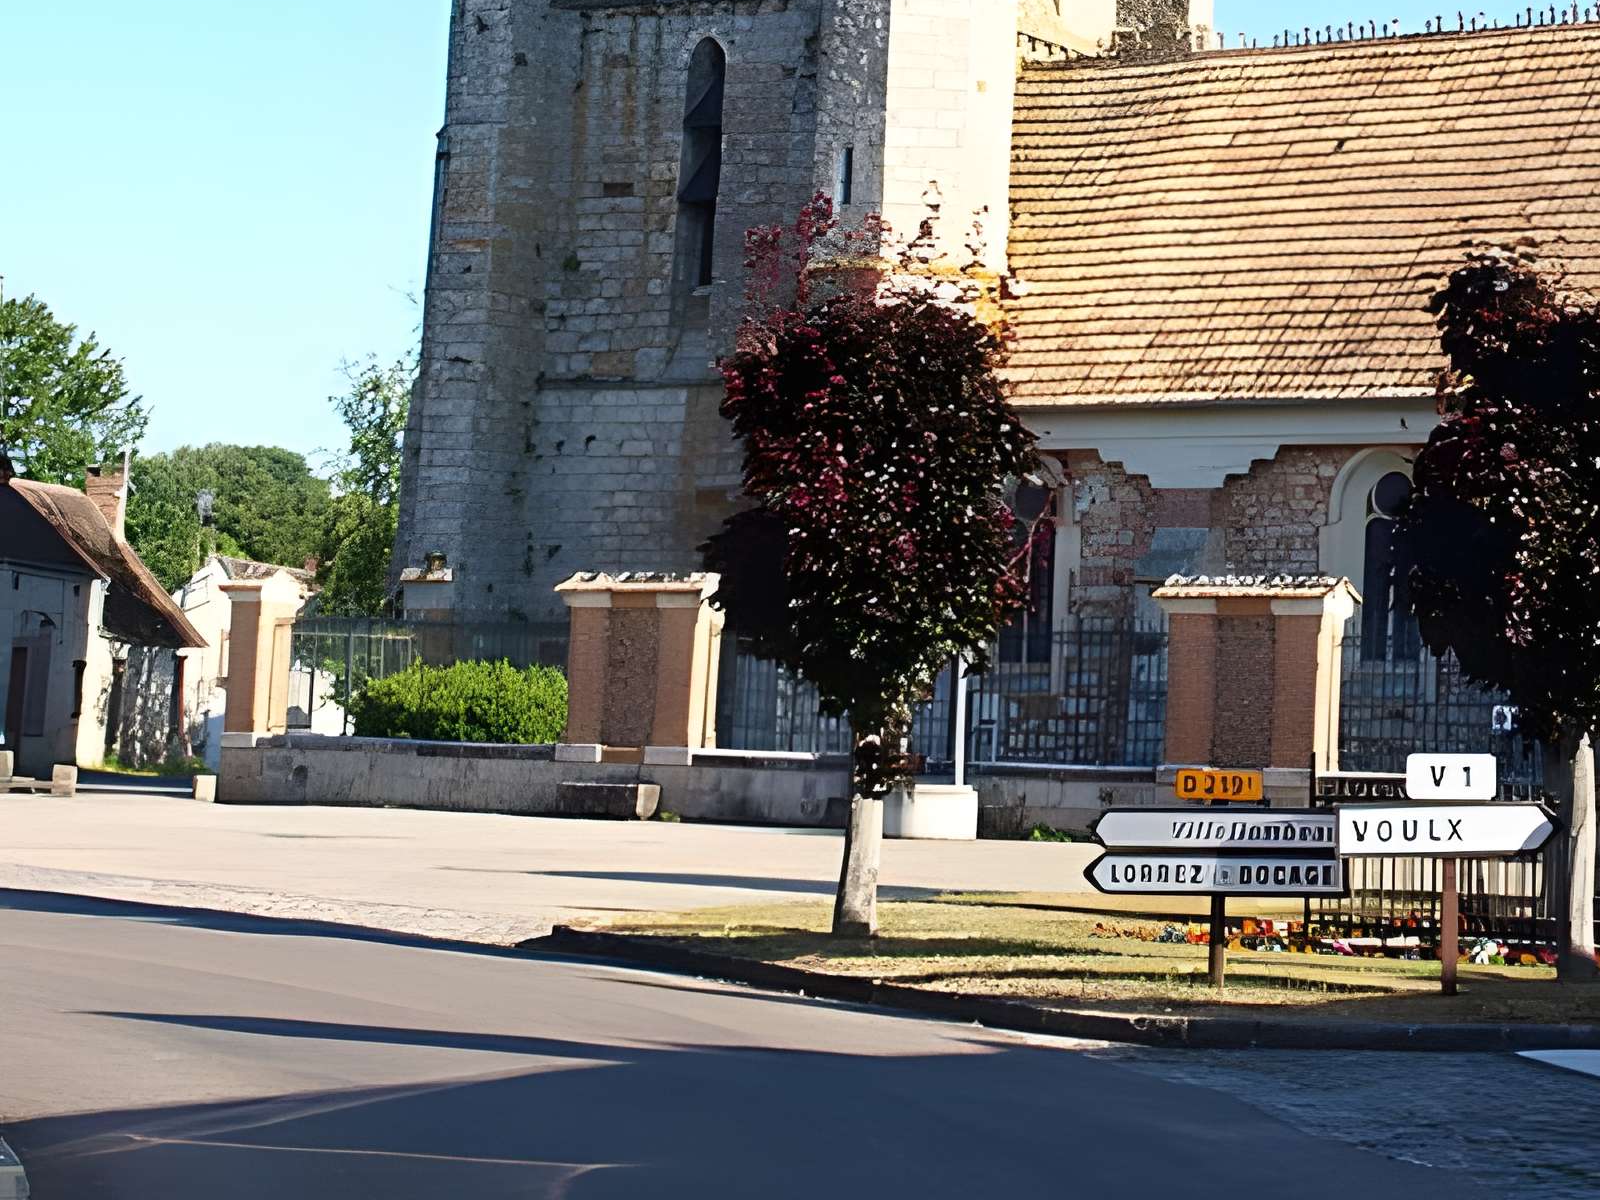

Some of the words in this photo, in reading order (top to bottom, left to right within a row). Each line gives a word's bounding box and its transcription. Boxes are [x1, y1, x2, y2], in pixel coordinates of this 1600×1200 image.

[1430, 765, 1446, 787] V
[1462, 766, 1471, 787] 1
[1352, 819, 1463, 842] VOULX
